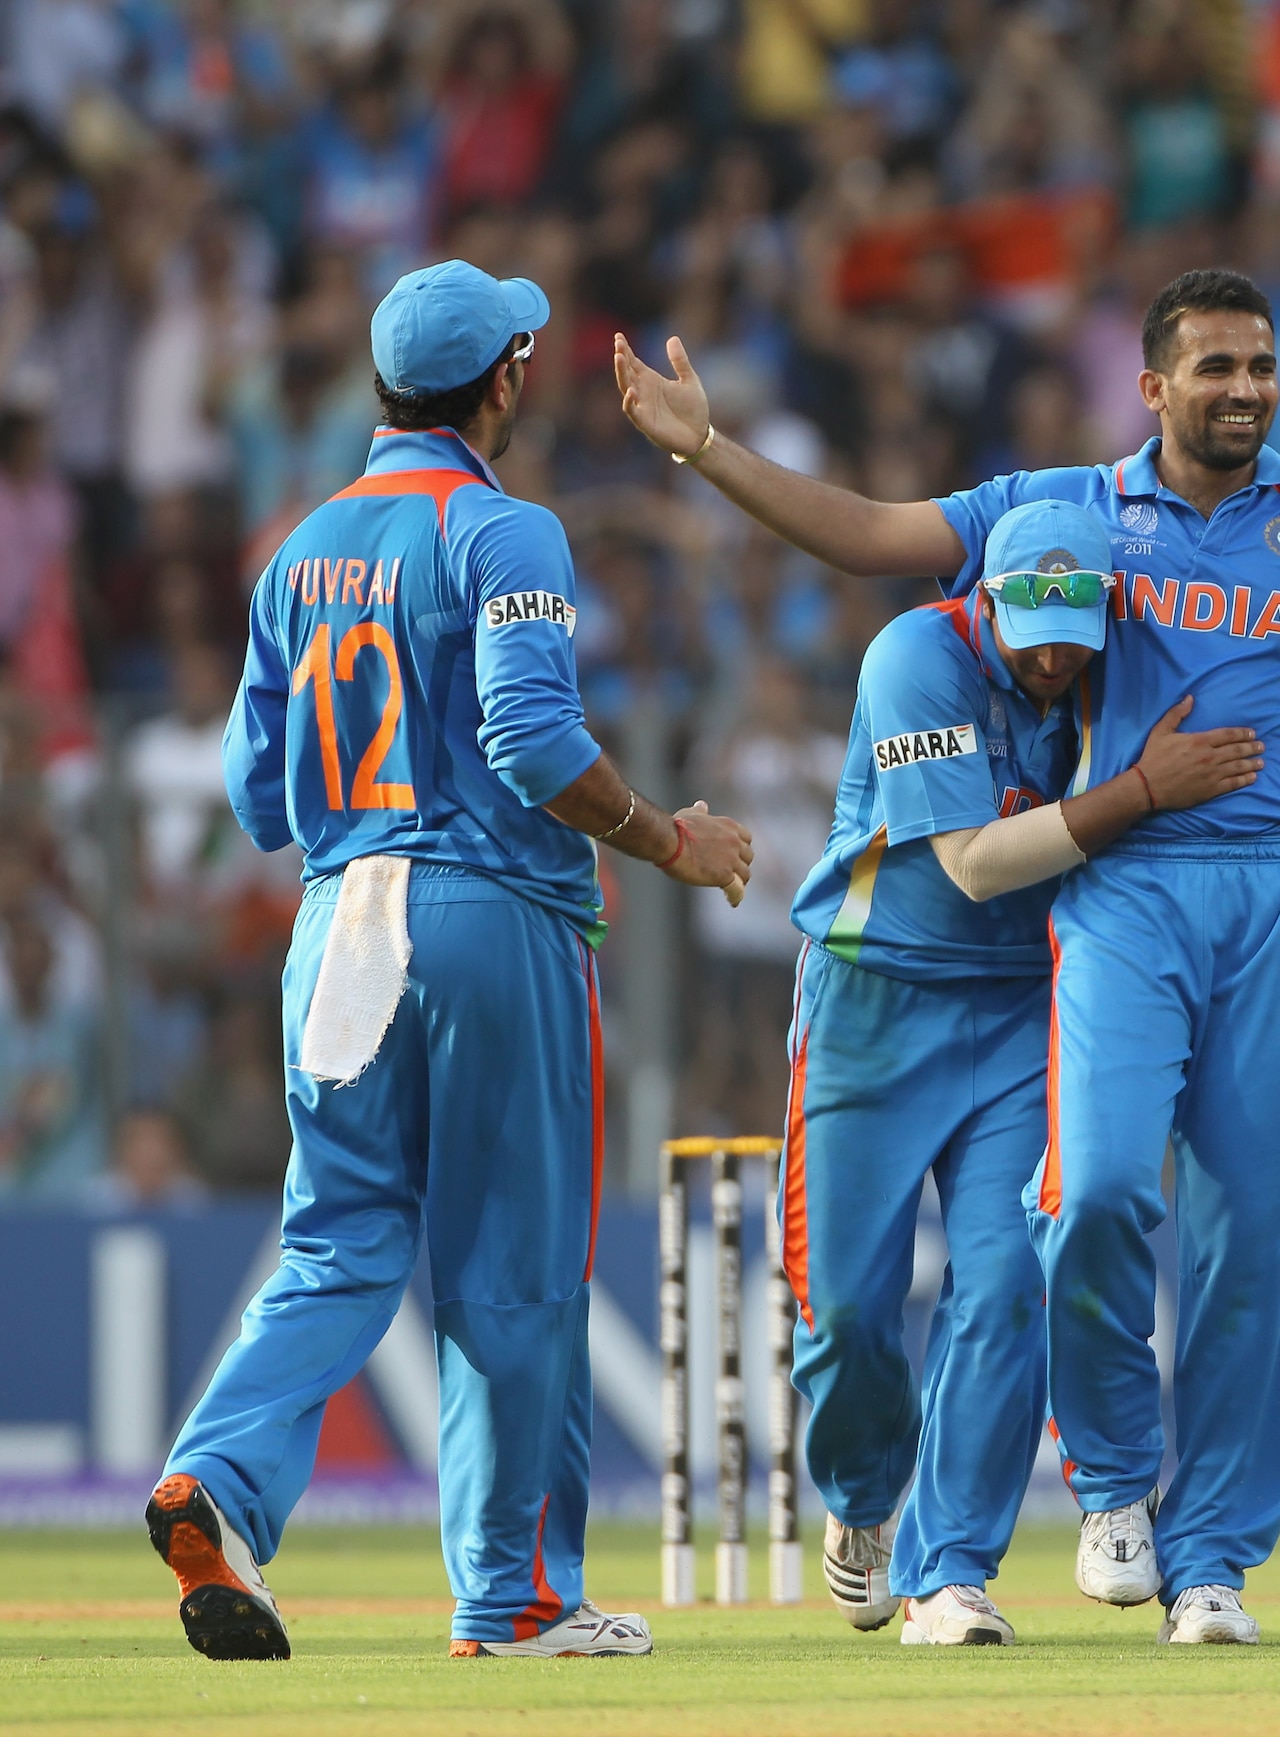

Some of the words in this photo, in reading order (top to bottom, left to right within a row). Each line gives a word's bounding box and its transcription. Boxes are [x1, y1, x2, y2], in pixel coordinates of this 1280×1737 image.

[1124, 543, 1152, 555] 2011
[288, 557, 400, 606] YUVRAJ
[488, 592, 567, 626] SAHAR
[292, 621, 417, 811] 12
[876, 729, 964, 769] SAHARA
[986, 744, 1008, 757] 2011
